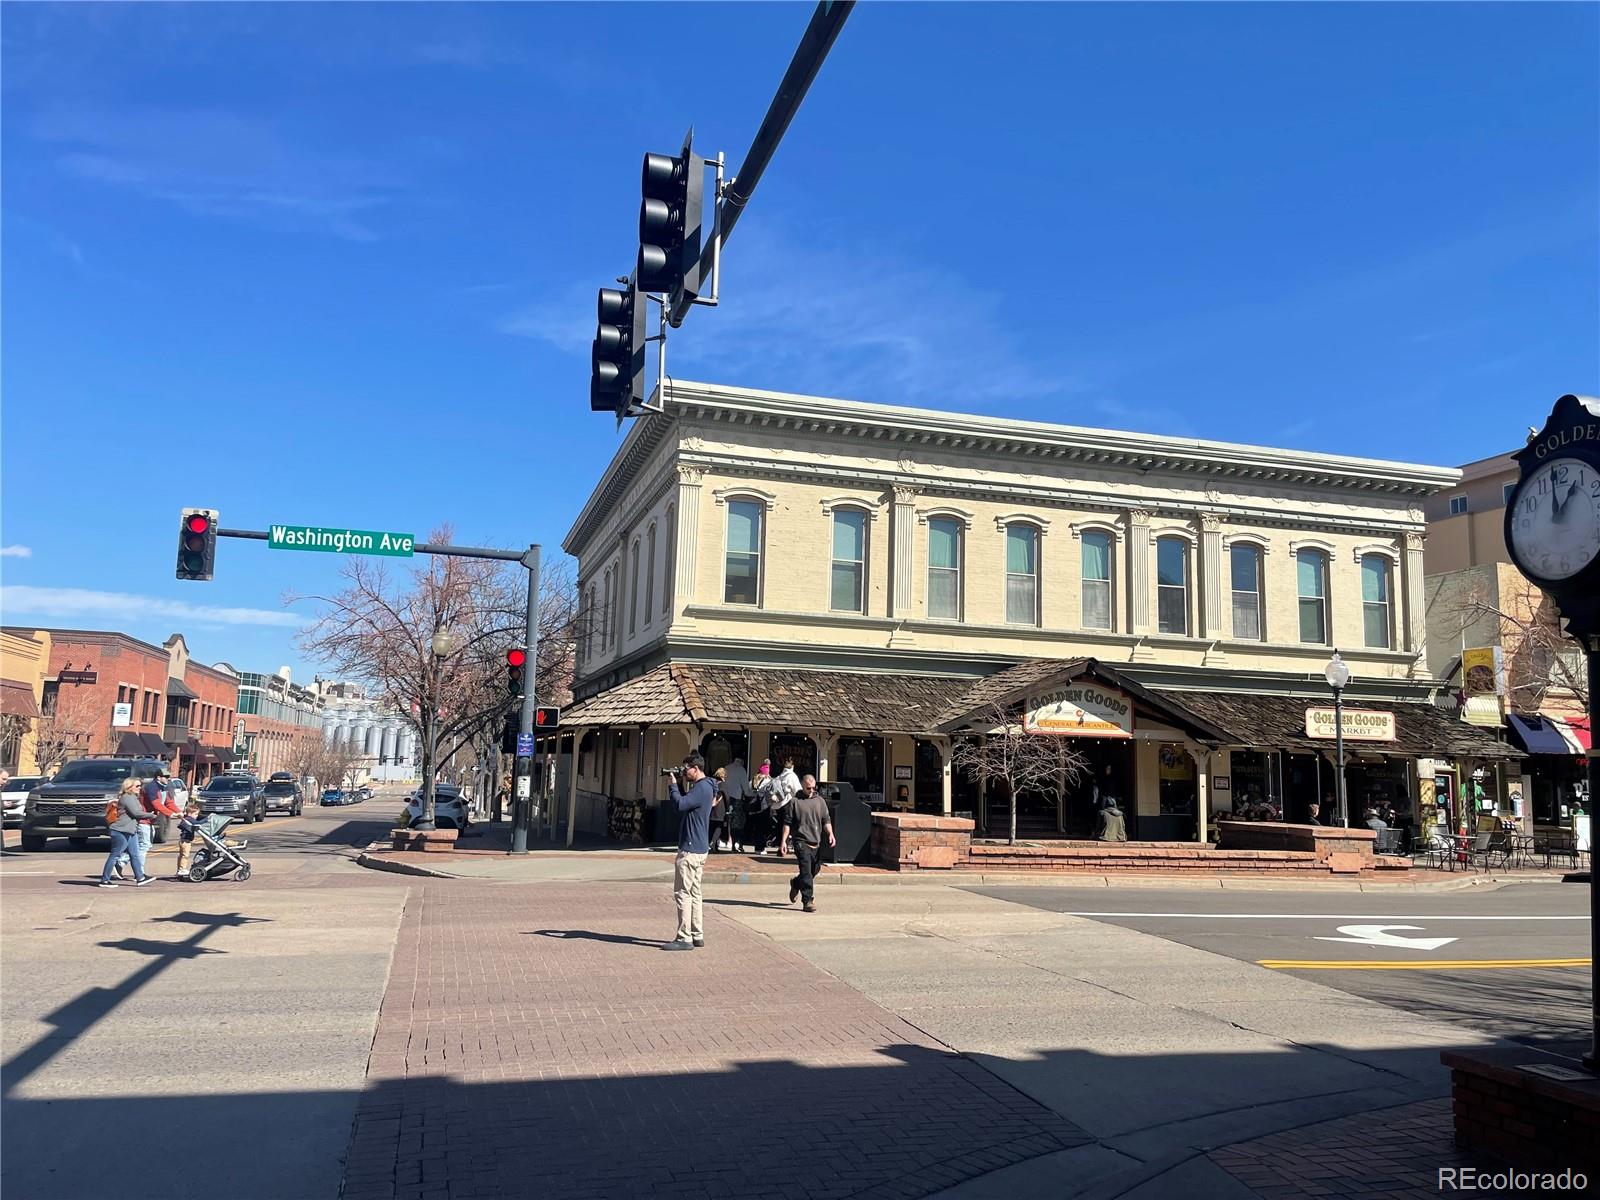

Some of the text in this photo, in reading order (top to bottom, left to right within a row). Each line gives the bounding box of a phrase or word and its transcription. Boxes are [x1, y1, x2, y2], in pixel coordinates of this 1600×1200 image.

[1535, 423, 1600, 459] GOLDE
[1525, 496, 1537, 513] 10
[272, 525, 412, 552] Washington Ave
[1030, 688, 1129, 716] GOLDEN GOODS
[1354, 713, 1388, 727] GOODS
